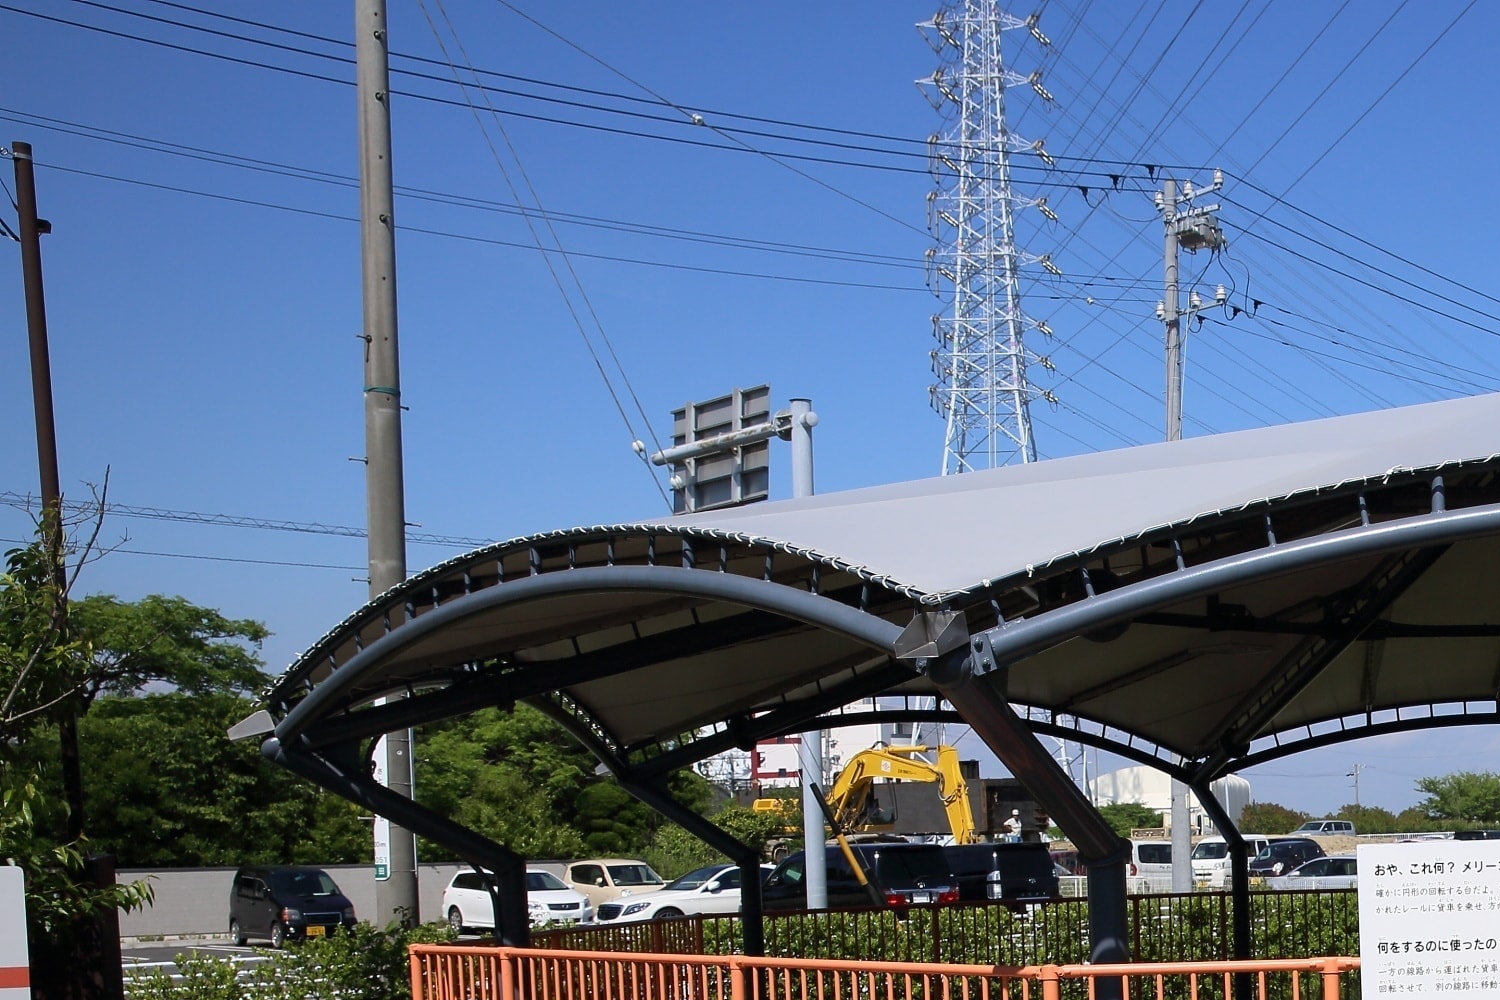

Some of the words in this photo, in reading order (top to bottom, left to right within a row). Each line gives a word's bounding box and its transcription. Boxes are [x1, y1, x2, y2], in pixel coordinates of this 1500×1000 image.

[1375, 862, 1455, 876] おや、これ何？
